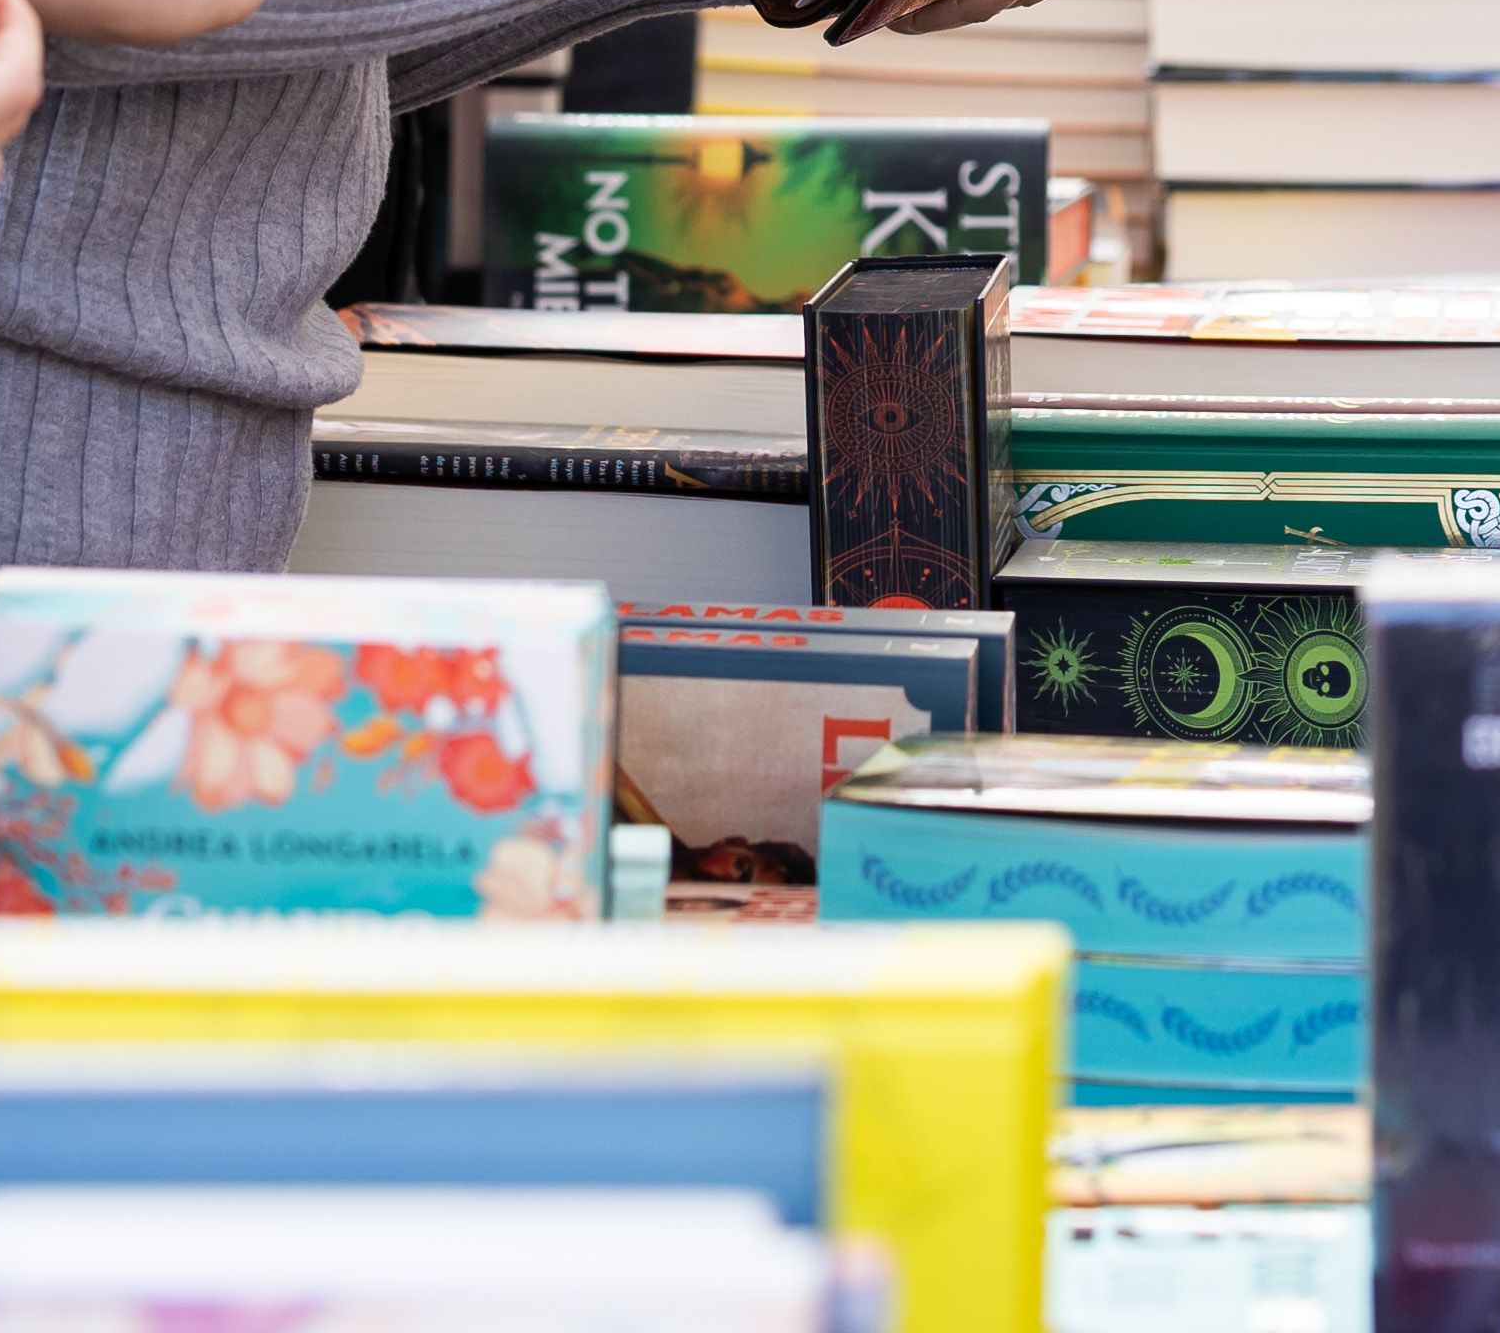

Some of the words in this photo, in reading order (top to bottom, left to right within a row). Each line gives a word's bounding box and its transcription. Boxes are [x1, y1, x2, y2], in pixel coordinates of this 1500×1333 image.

[583, 172, 630, 255] NO
[616, 602, 845, 623] LAMAS
[622, 629, 809, 647] AMAS
